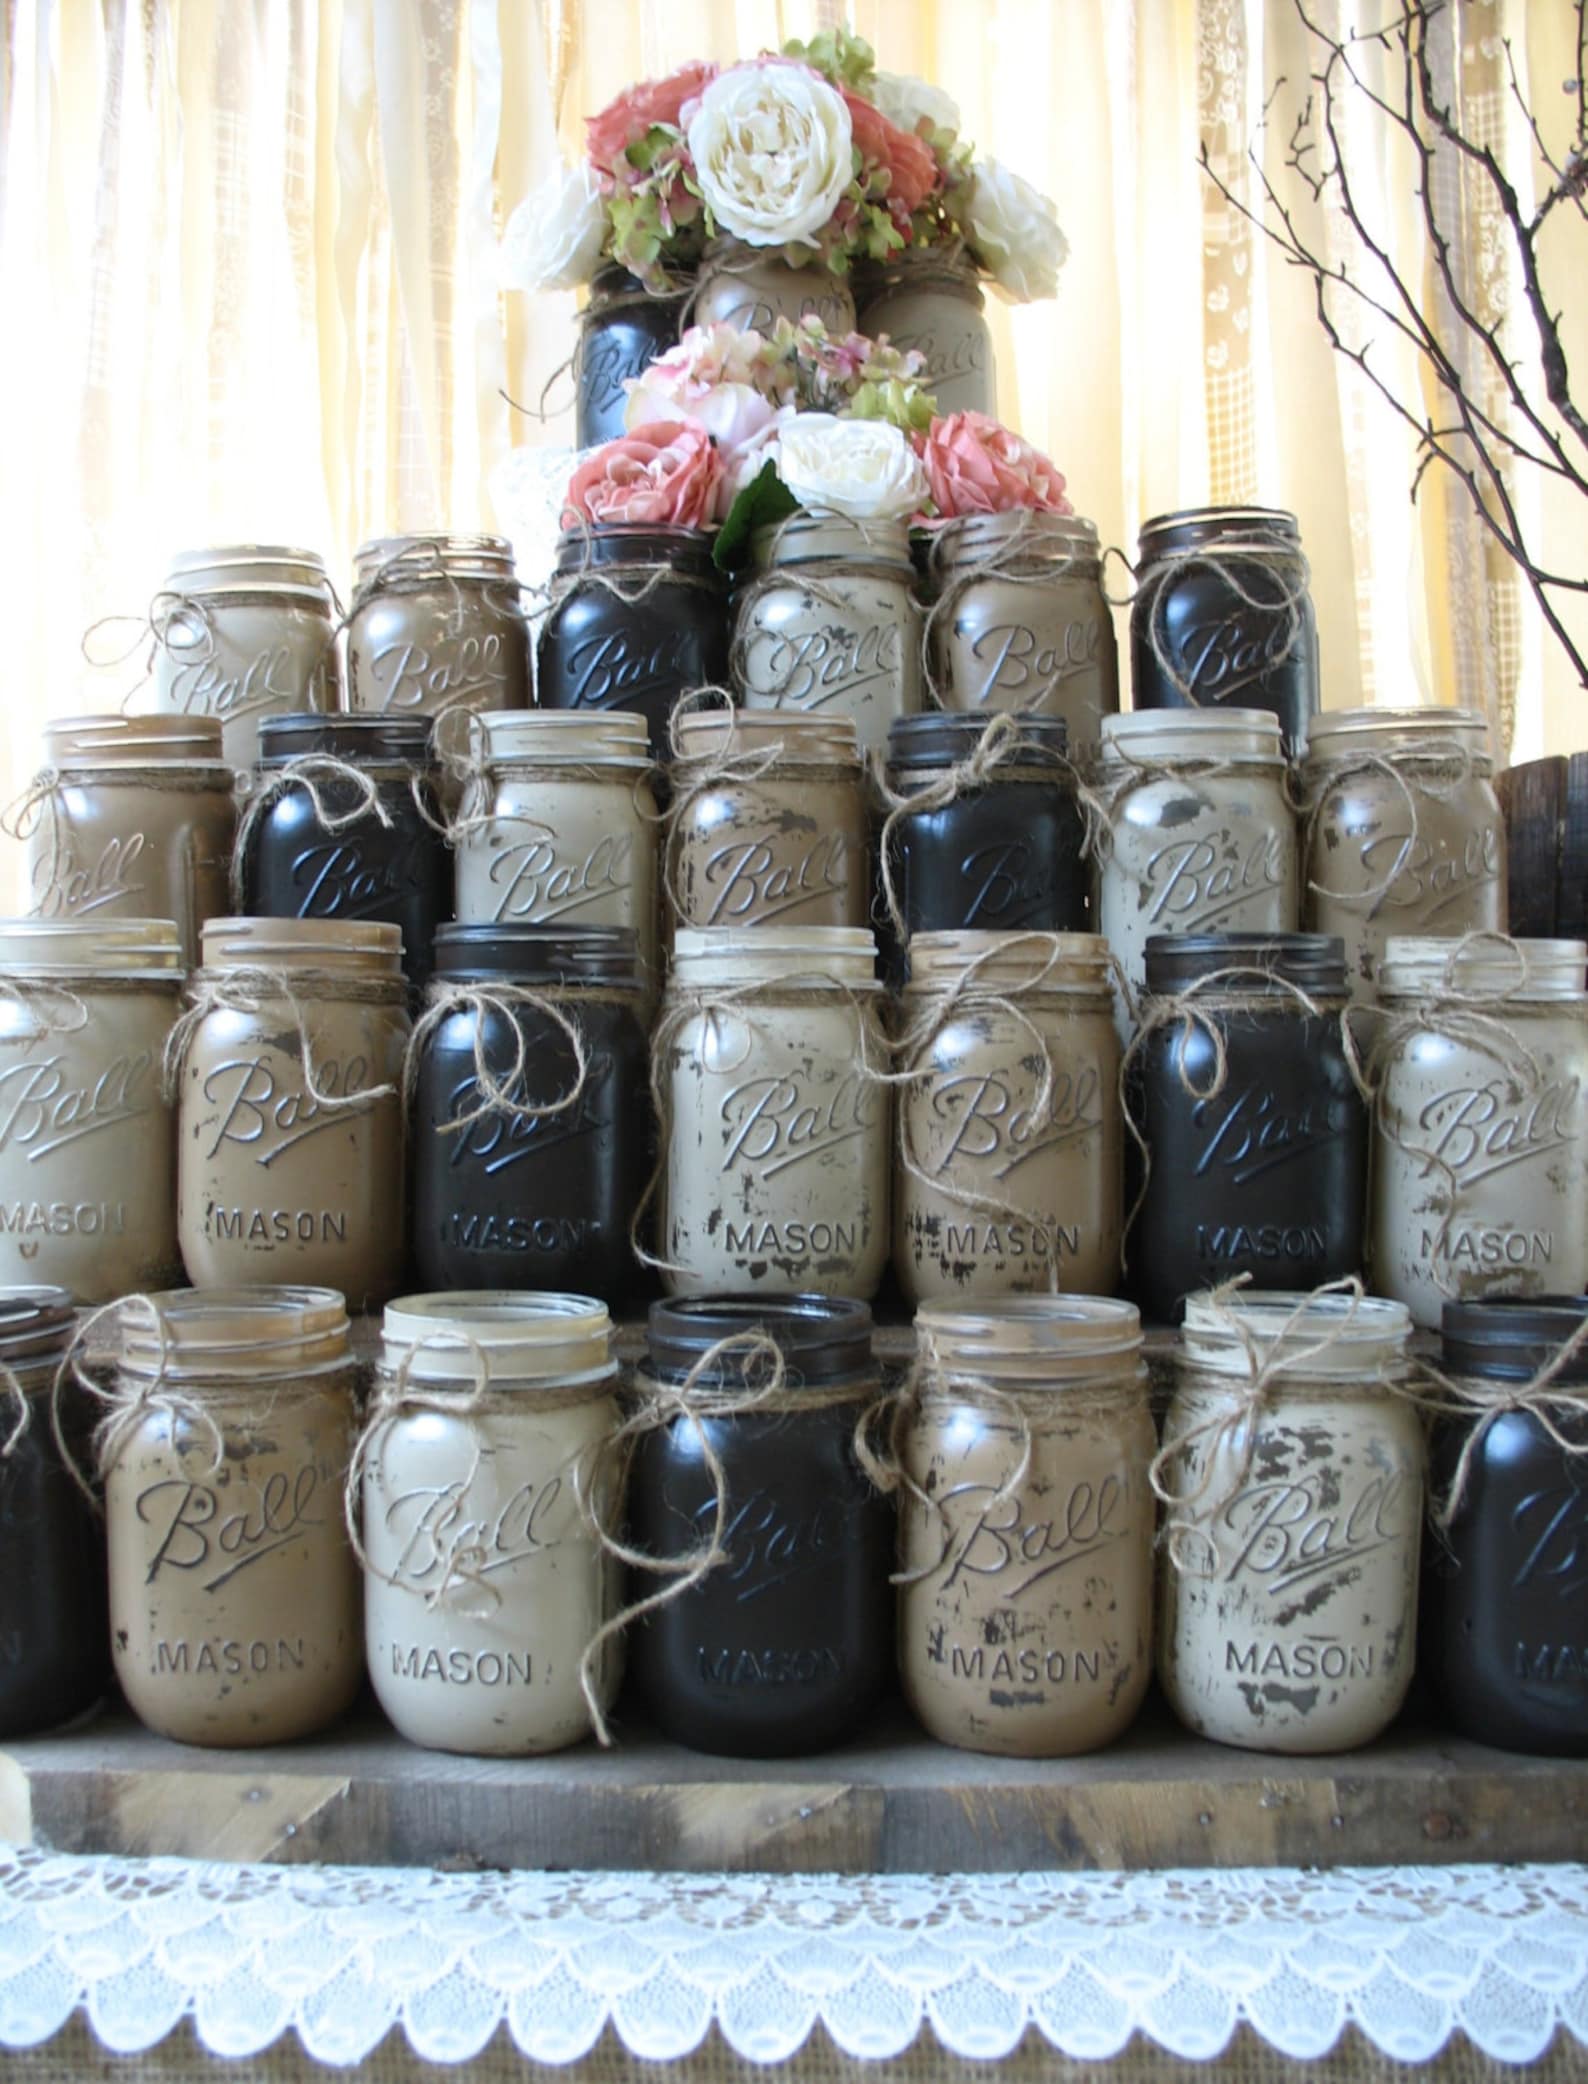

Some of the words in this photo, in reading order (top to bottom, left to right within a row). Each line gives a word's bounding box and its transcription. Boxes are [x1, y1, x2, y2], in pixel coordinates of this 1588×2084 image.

[171, 646, 294, 715] Ball
[372, 634, 512, 714] Ball
[567, 626, 700, 708] Ball
[769, 620, 898, 709] Ball
[971, 618, 1099, 704] Ball
[489, 831, 634, 922] Ball
[705, 833, 850, 925] Ball
[1147, 826, 1283, 925] Ball
[1360, 827, 1500, 922] Ball
[0, 1055, 151, 1158] Ball
[203, 1055, 374, 1162] Ball
[721, 1069, 876, 1174] Ball
[932, 1066, 1102, 1176] Ball
[1418, 1076, 1580, 1182] Ball
[0, 1201, 124, 1234] MASON
[215, 1207, 348, 1242] MASON
[452, 1213, 588, 1250] MASON
[724, 1221, 857, 1254] MASON
[947, 1222, 1080, 1256] MASON
[1196, 1223, 1329, 1258] MASON
[1420, 1229, 1553, 1264] MASON
[136, 1465, 326, 1586] Ball
[937, 1474, 1130, 1591] Ball
[1225, 1470, 1405, 1585] Ball
[155, 1640, 305, 1676] MASON
[391, 1641, 533, 1687] MASON
[951, 1644, 1100, 1684] MASON
[1225, 1640, 1374, 1680] MASON
